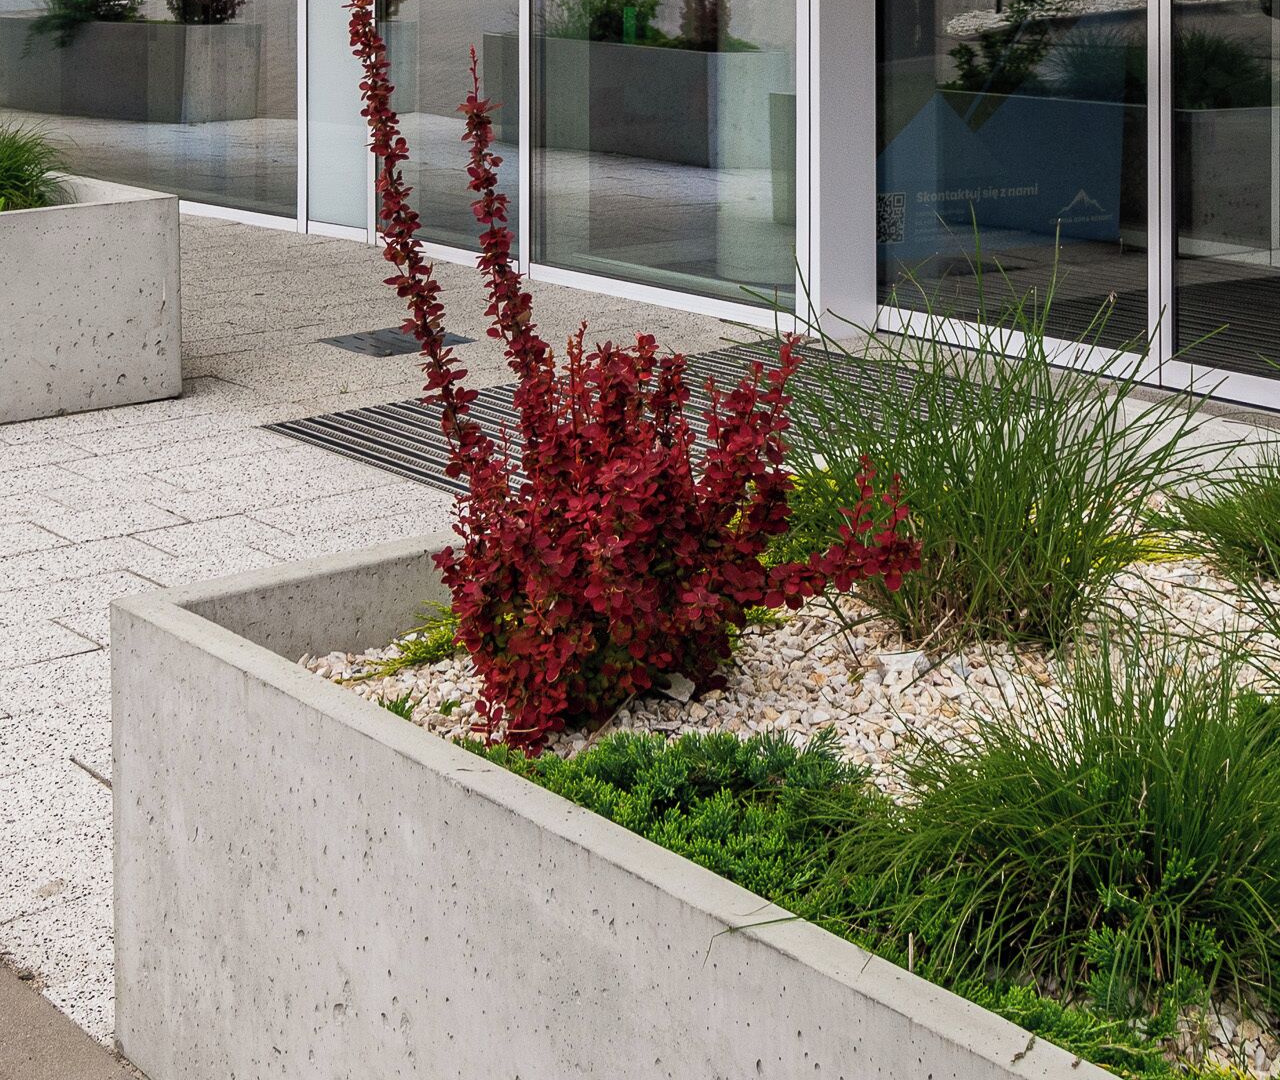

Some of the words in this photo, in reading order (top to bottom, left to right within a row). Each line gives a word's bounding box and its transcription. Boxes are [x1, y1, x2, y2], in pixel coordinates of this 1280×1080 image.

[916, 188, 982, 204] Skontaktuj
[982, 187, 1000, 201] się
[1000, 189, 1007, 199] z
[1007, 184, 1039, 198] nami
